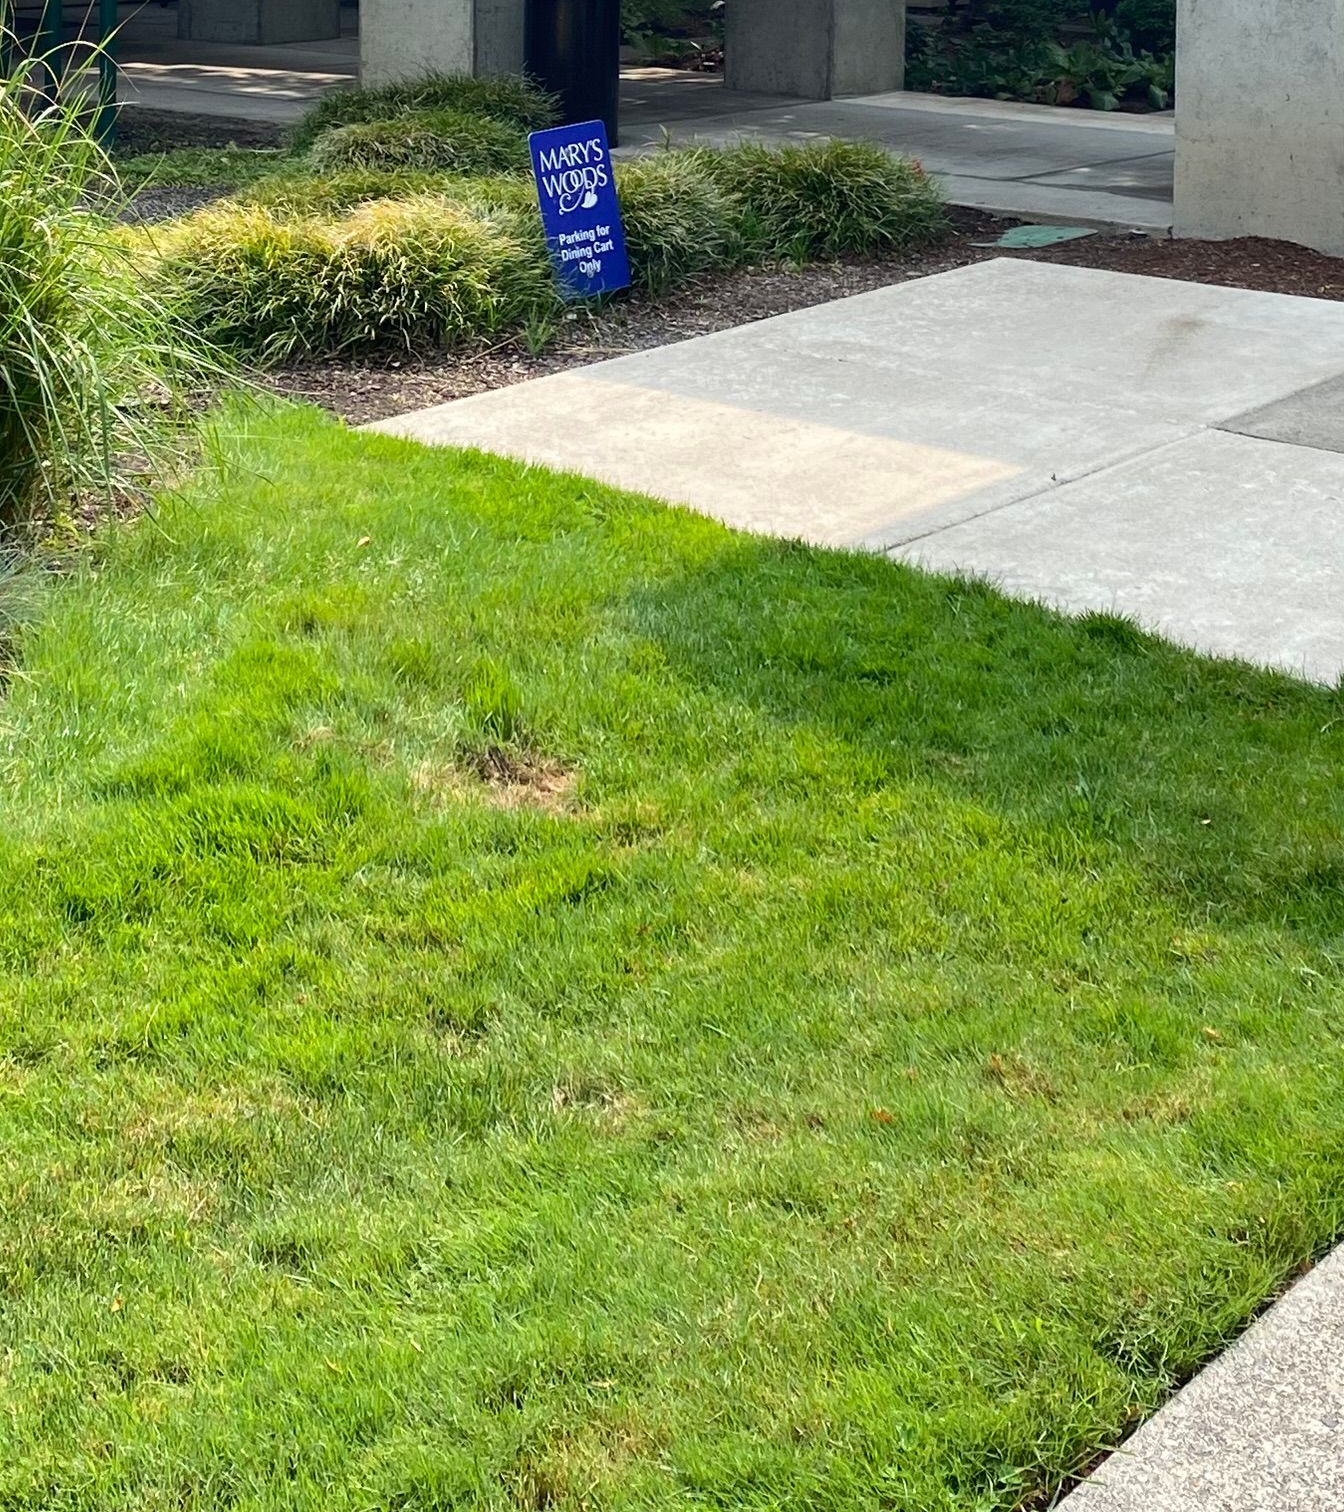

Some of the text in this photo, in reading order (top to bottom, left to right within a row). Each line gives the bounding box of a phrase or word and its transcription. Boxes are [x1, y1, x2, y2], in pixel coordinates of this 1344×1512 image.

[539, 138, 603, 172] MARY'S
[541, 163, 608, 198] WOODS
[558, 224, 611, 246] Parking for
[561, 239, 614, 262] Dining Cart
[579, 258, 602, 274] Only
